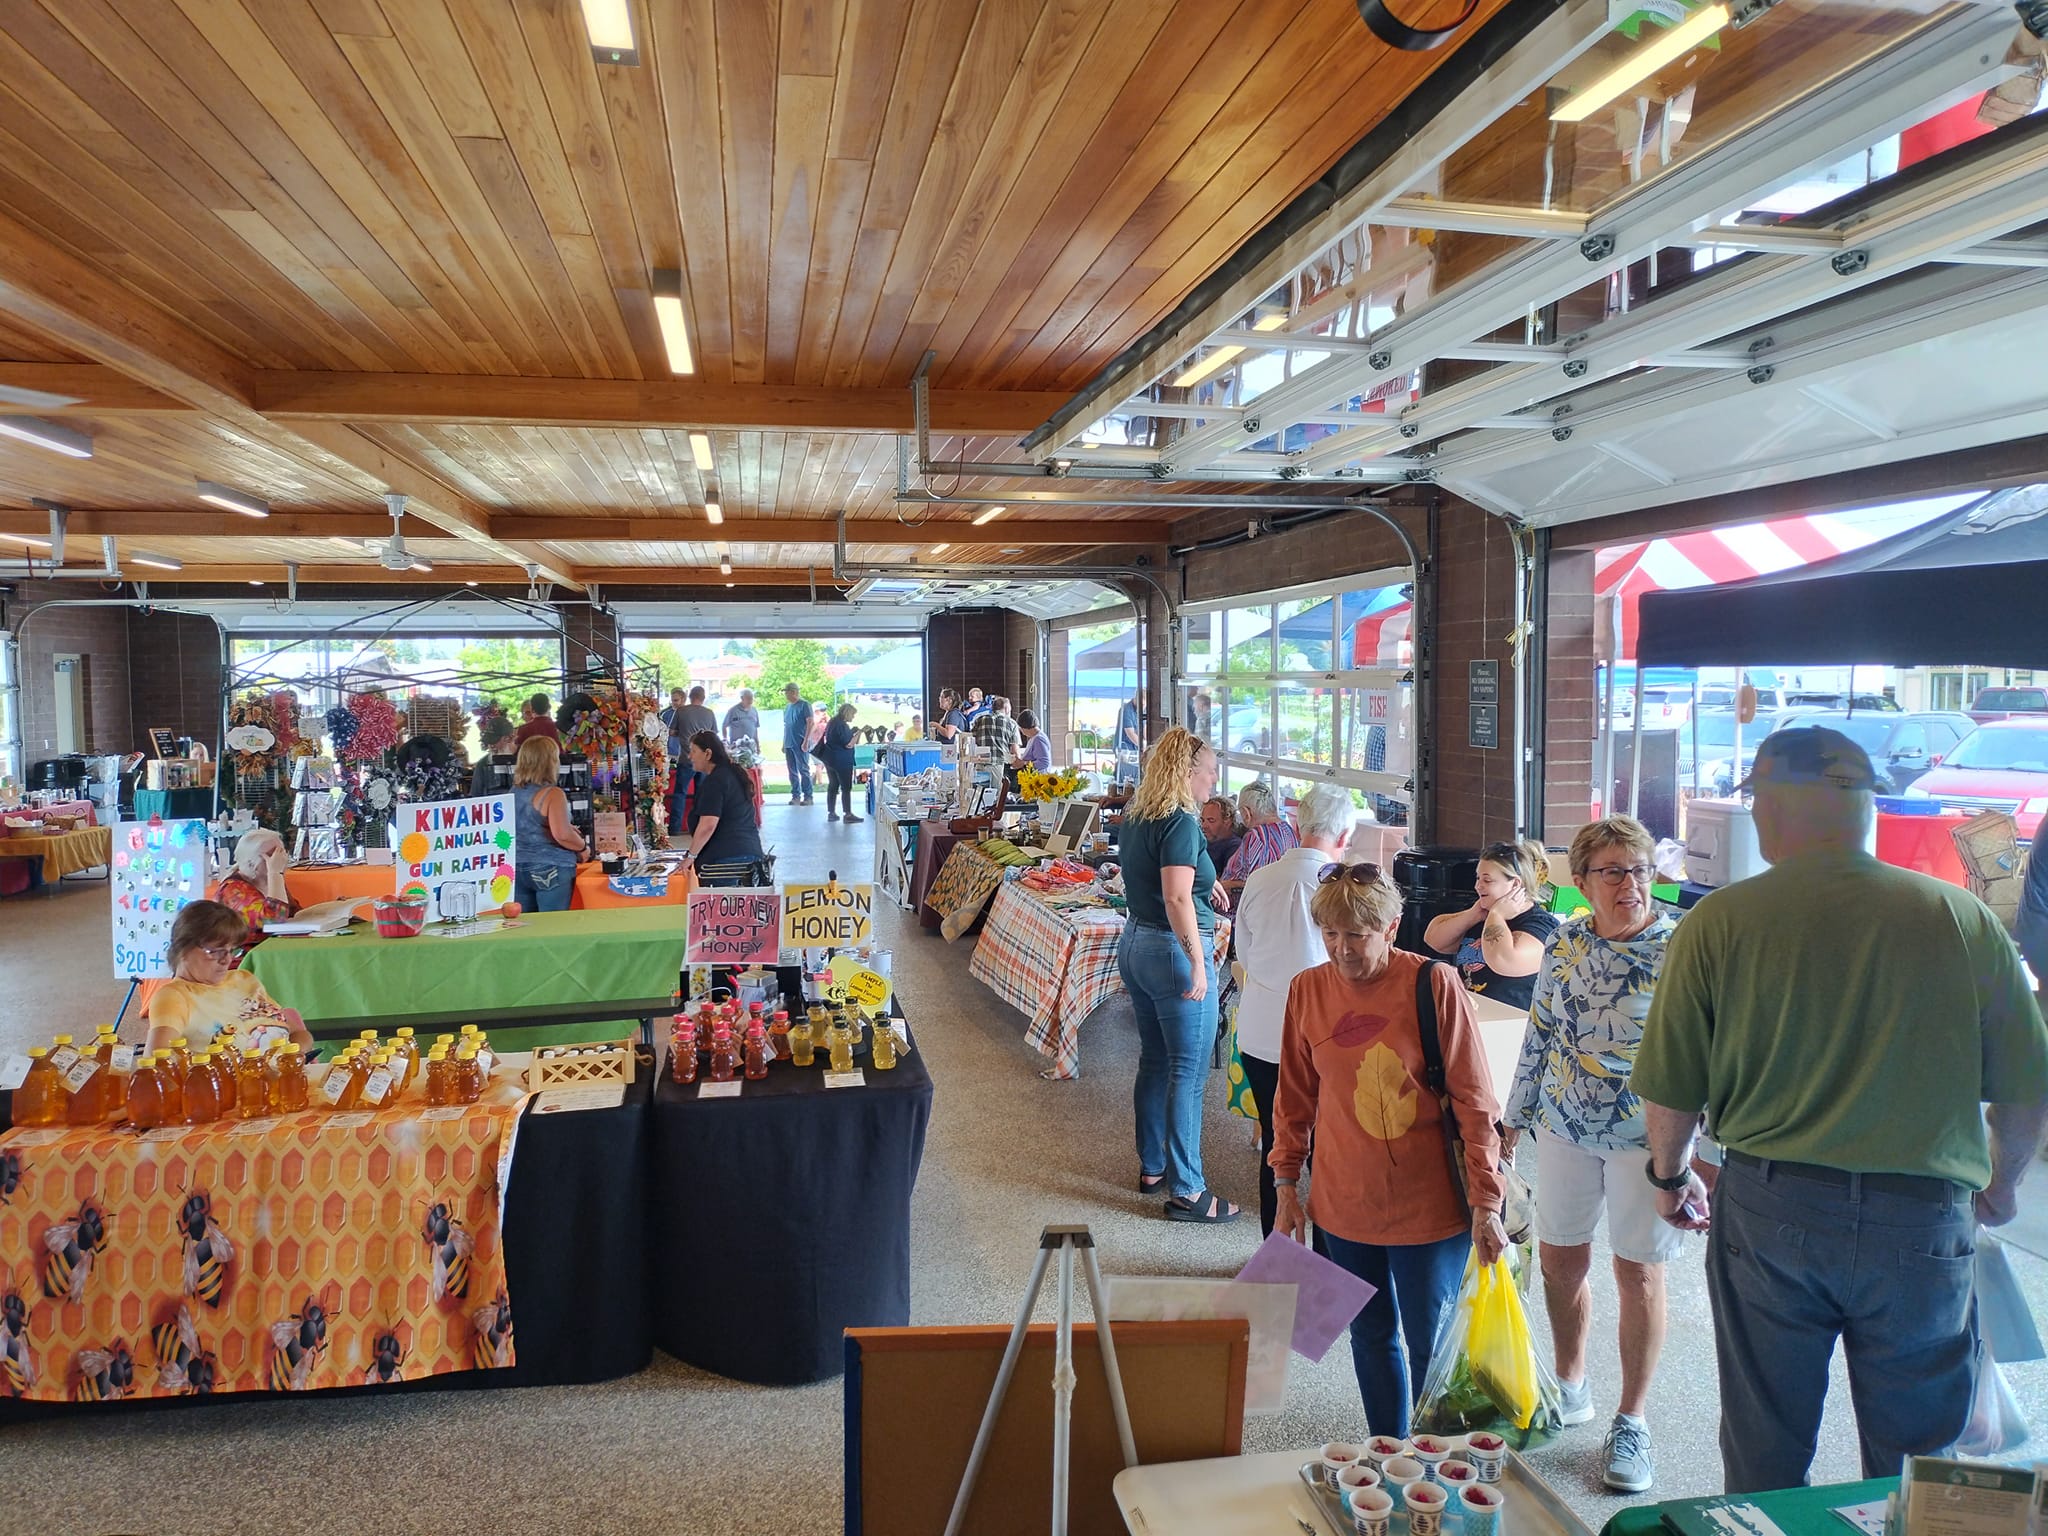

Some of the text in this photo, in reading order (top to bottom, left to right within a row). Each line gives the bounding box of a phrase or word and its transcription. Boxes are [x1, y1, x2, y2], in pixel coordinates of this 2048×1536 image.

[415, 801, 504, 833] KIWANIS
[433, 830, 489, 851] ANNUAL
[409, 853, 506, 878] GUN RAFFLE
[690, 896, 777, 926] TRY OUR NEW
[785, 887, 871, 915] LEMON
[702, 924, 763, 936] HOT
[791, 916, 866, 939] HONEY
[701, 942, 764, 954] HONEY
[860, 972, 884, 987] SAMPLE
